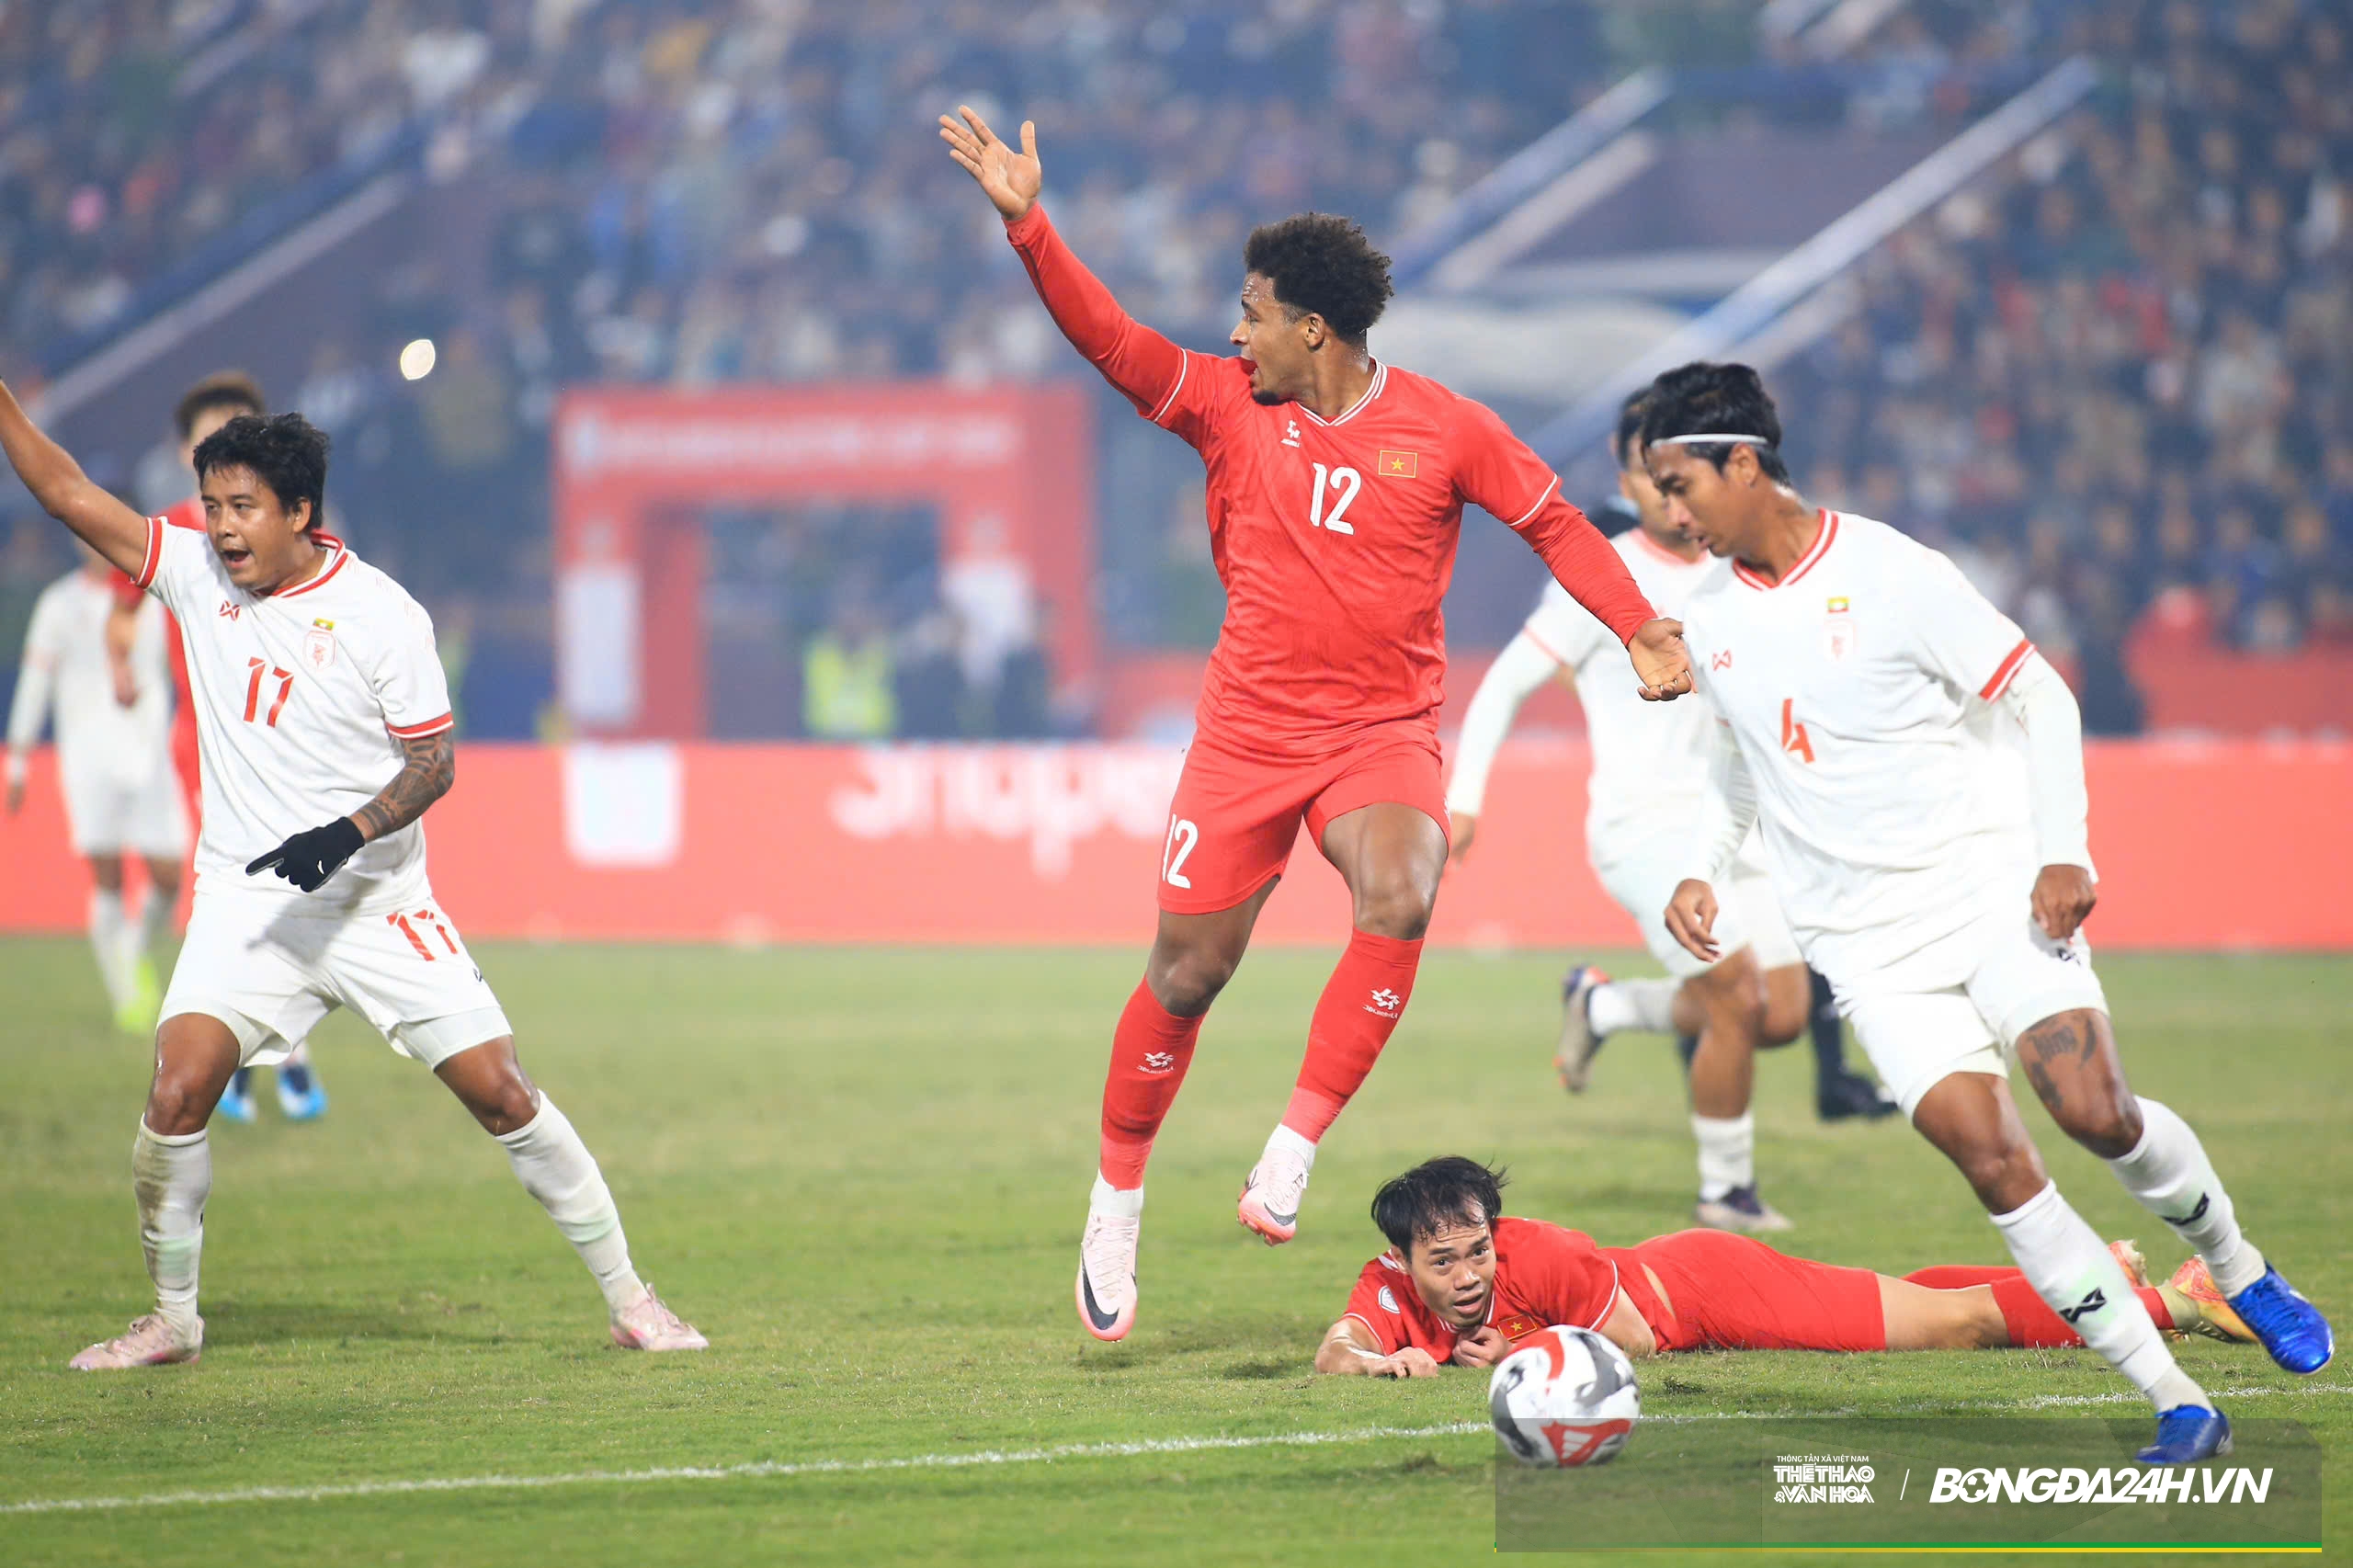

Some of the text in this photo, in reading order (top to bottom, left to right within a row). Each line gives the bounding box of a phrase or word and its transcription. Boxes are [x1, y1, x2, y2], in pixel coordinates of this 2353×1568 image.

[1309, 461, 1362, 536] 12
[243, 655, 295, 729] 17
[1781, 697, 1816, 764] 4
[1162, 812, 1199, 890] 12
